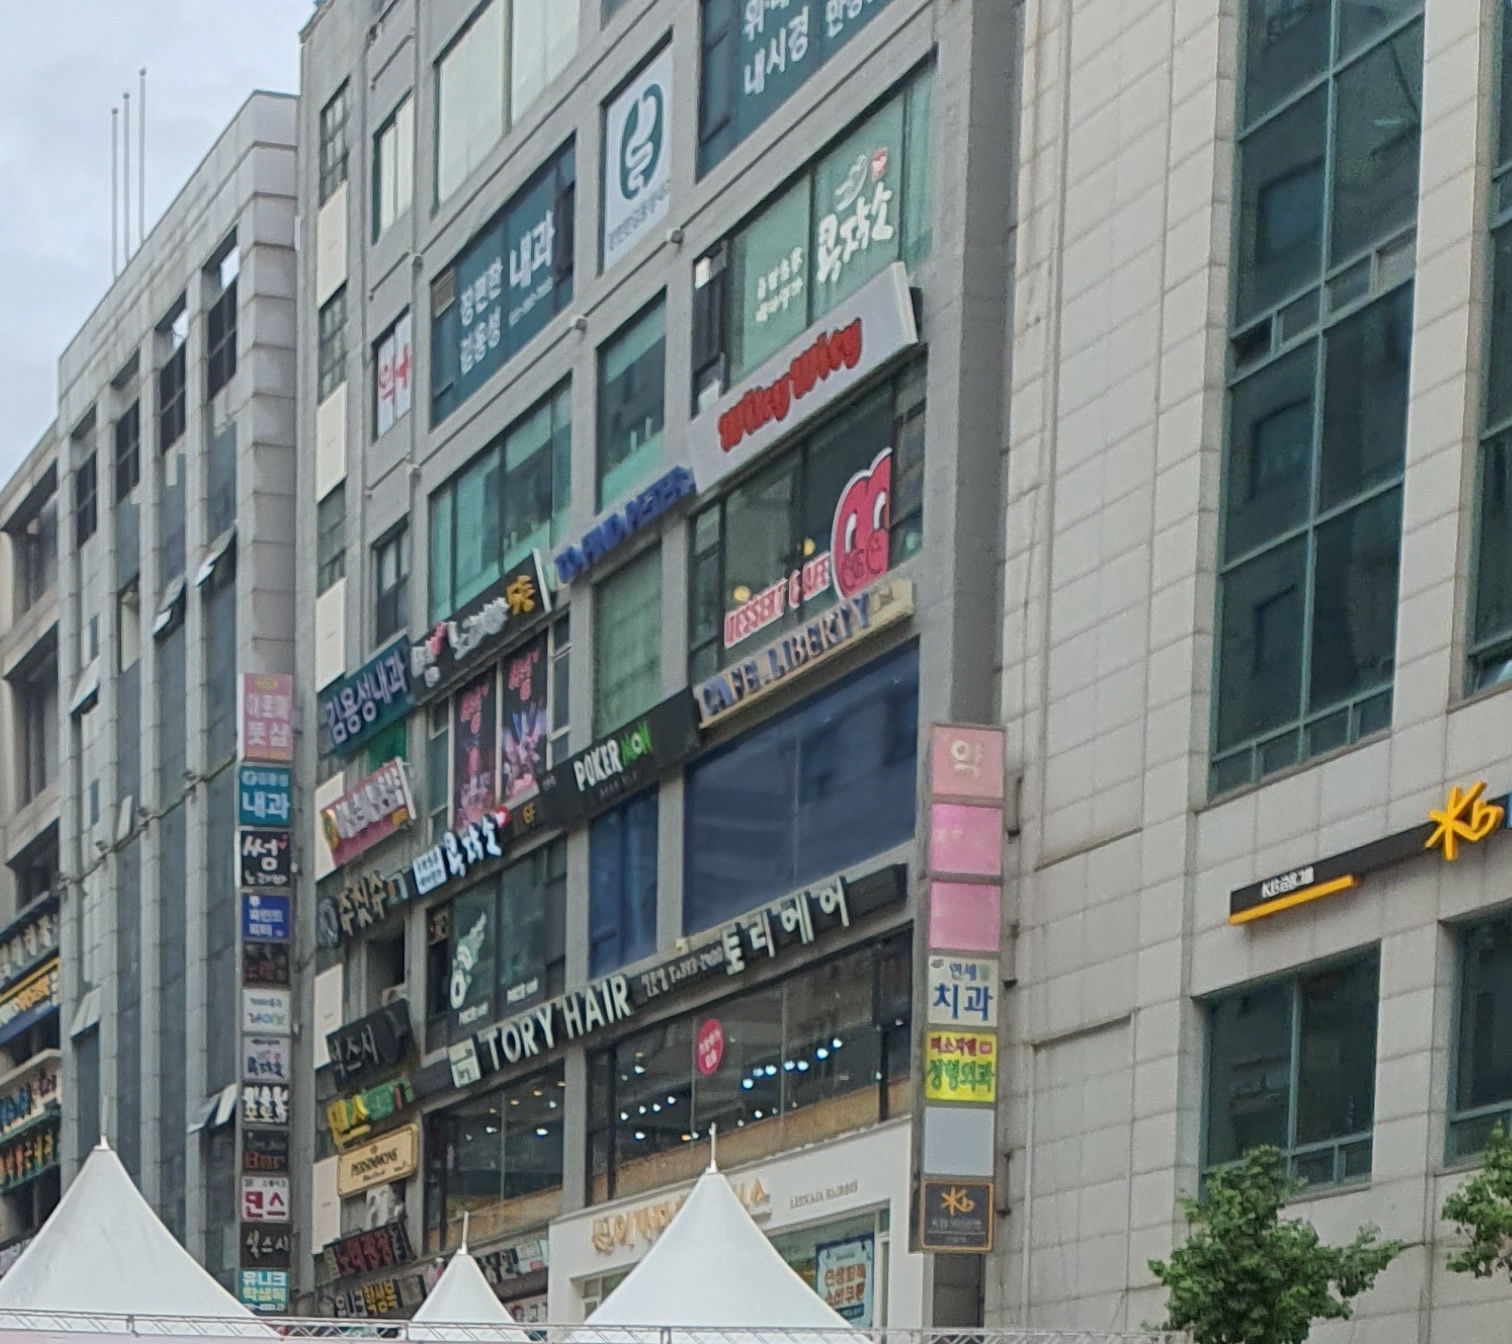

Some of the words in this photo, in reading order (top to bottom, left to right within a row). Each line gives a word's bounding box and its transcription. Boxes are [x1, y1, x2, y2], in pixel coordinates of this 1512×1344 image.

[744, 6, 808, 94] 내시경
[510, 209, 555, 288] 내과
[325, 650, 408, 745] 김용성내과
[242, 791, 290, 820] 내과
[722, 876, 850, 975] 토리헤어
[481, 1002, 555, 1072] TORY
[563, 975, 633, 1040] HAIR
[932, 983, 994, 1022] 치과
